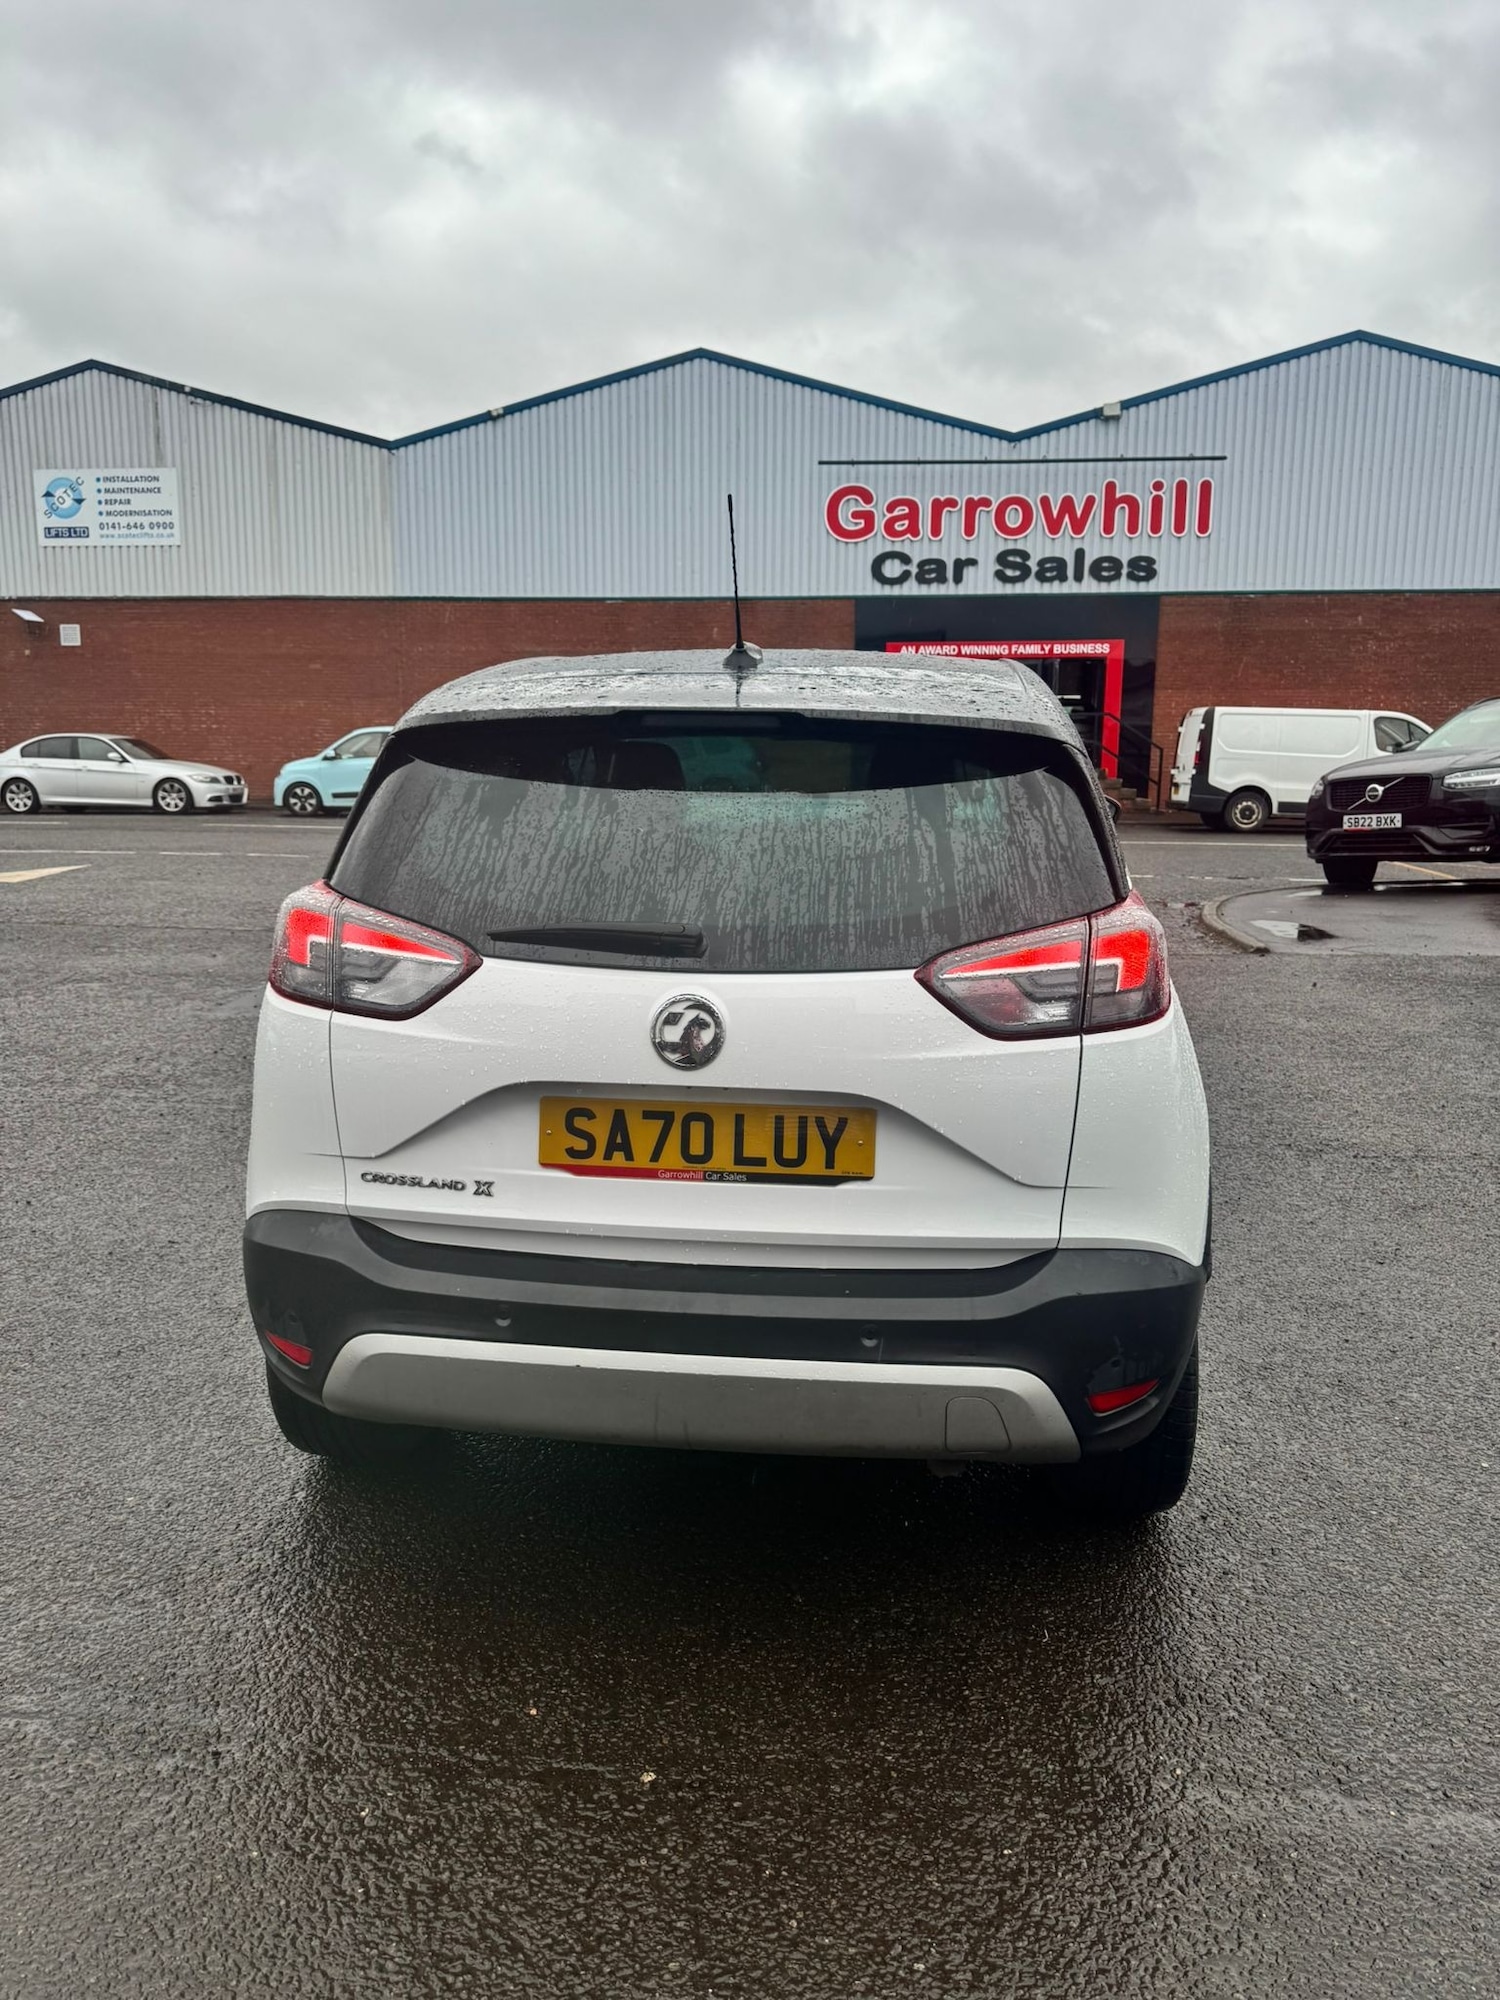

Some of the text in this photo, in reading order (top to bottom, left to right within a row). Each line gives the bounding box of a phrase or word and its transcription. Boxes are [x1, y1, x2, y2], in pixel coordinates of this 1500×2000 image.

[102, 475, 160, 483] INSTALLATION
[43, 476, 85, 519] SCOTEC
[105, 509, 173, 517] MODERNISATION
[825, 477, 1214, 543] Garrowhill
[45, 528, 88, 537] LIFTS LTD
[99, 521, 175, 531] 0141-646 0900
[870, 547, 1158, 585] Car Sales
[900, 643, 1110, 655] AN AWARD WINNING FAMILY BUSINESS
[1347, 815, 1397, 828] SB22 BXK
[564, 1107, 849, 1170] SA70 LUY
[657, 1169, 748, 1182] Garrowhill Car Sales
[361, 1172, 495, 1197] CROSSLAND X
